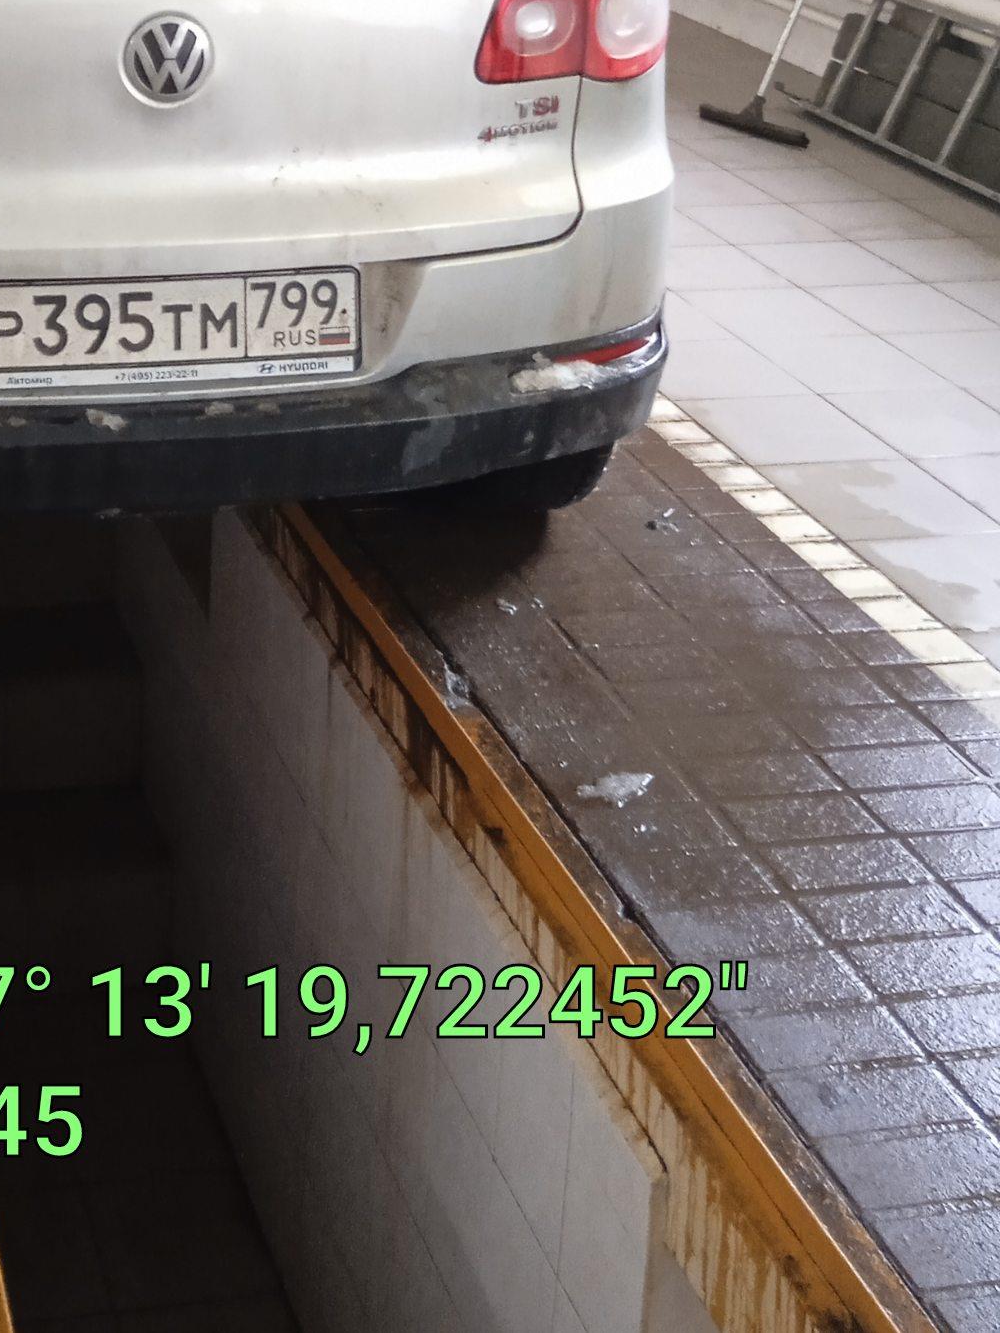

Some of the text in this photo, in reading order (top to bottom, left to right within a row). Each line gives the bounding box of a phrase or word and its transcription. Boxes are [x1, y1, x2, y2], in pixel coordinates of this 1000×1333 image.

[514, 95, 559, 119] TSI
[250, 279, 339, 329] 799
[273, 330, 317, 349] RUS
[279, 360, 329, 372] HYUNDAI
